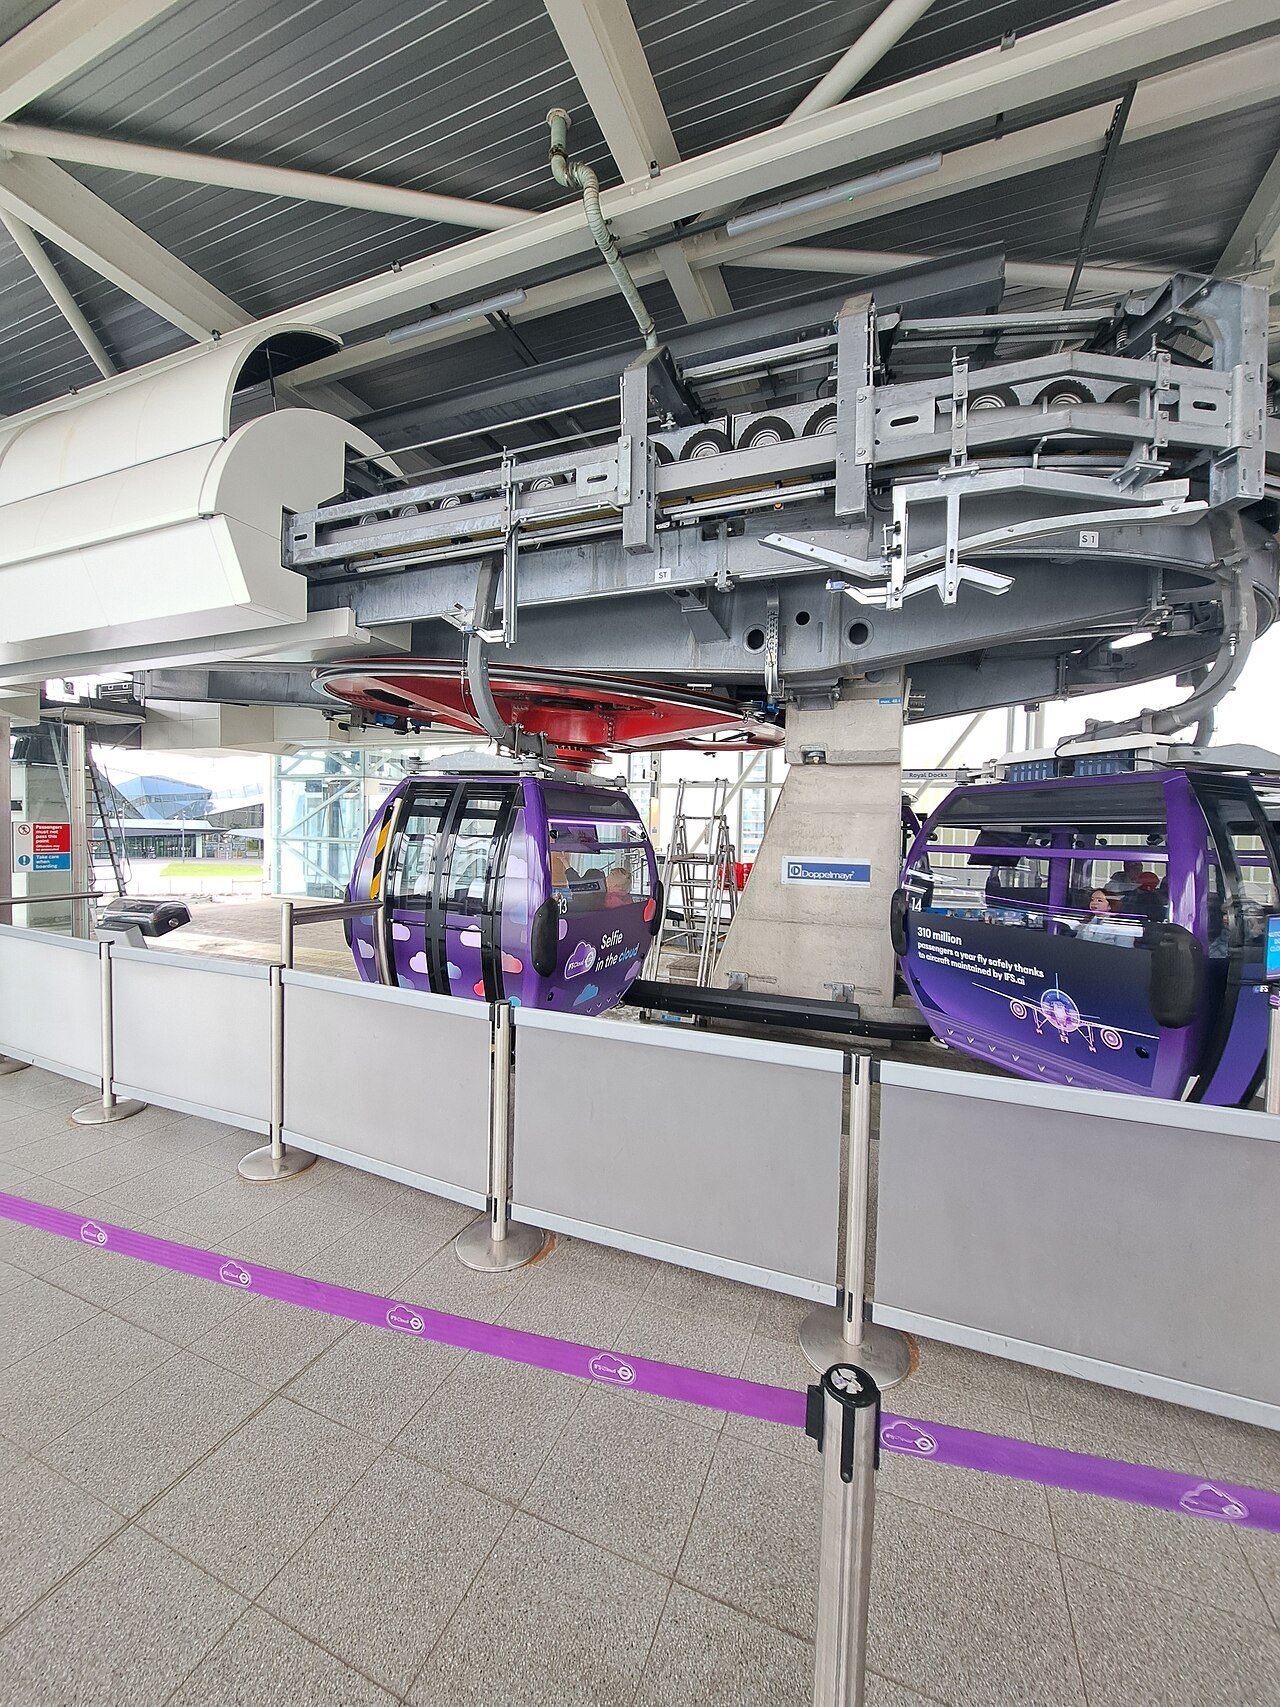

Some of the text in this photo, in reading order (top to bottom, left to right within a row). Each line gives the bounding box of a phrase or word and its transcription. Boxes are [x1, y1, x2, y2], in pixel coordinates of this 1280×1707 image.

[1081, 534, 1088, 543] S
[658, 571, 667, 580] ST
[801, 870, 854, 881] Doppelmayr
[912, 897, 922, 912] 14
[600, 930, 624, 950] Selfie
[918, 927, 962, 946] 310 million
[595, 943, 640, 972] in the cloud
[917, 942, 954, 956] passengers
[960, 952, 976, 962] year
[977, 954, 988, 966] fly
[988, 959, 1014, 972] safely
[1014, 964, 1044, 978] thanks
[926, 954, 950, 966] aircraft
[950, 960, 992, 977] maintained
[992, 969, 1003, 980] by
[1004, 972, 1026, 986] IFS.ai
